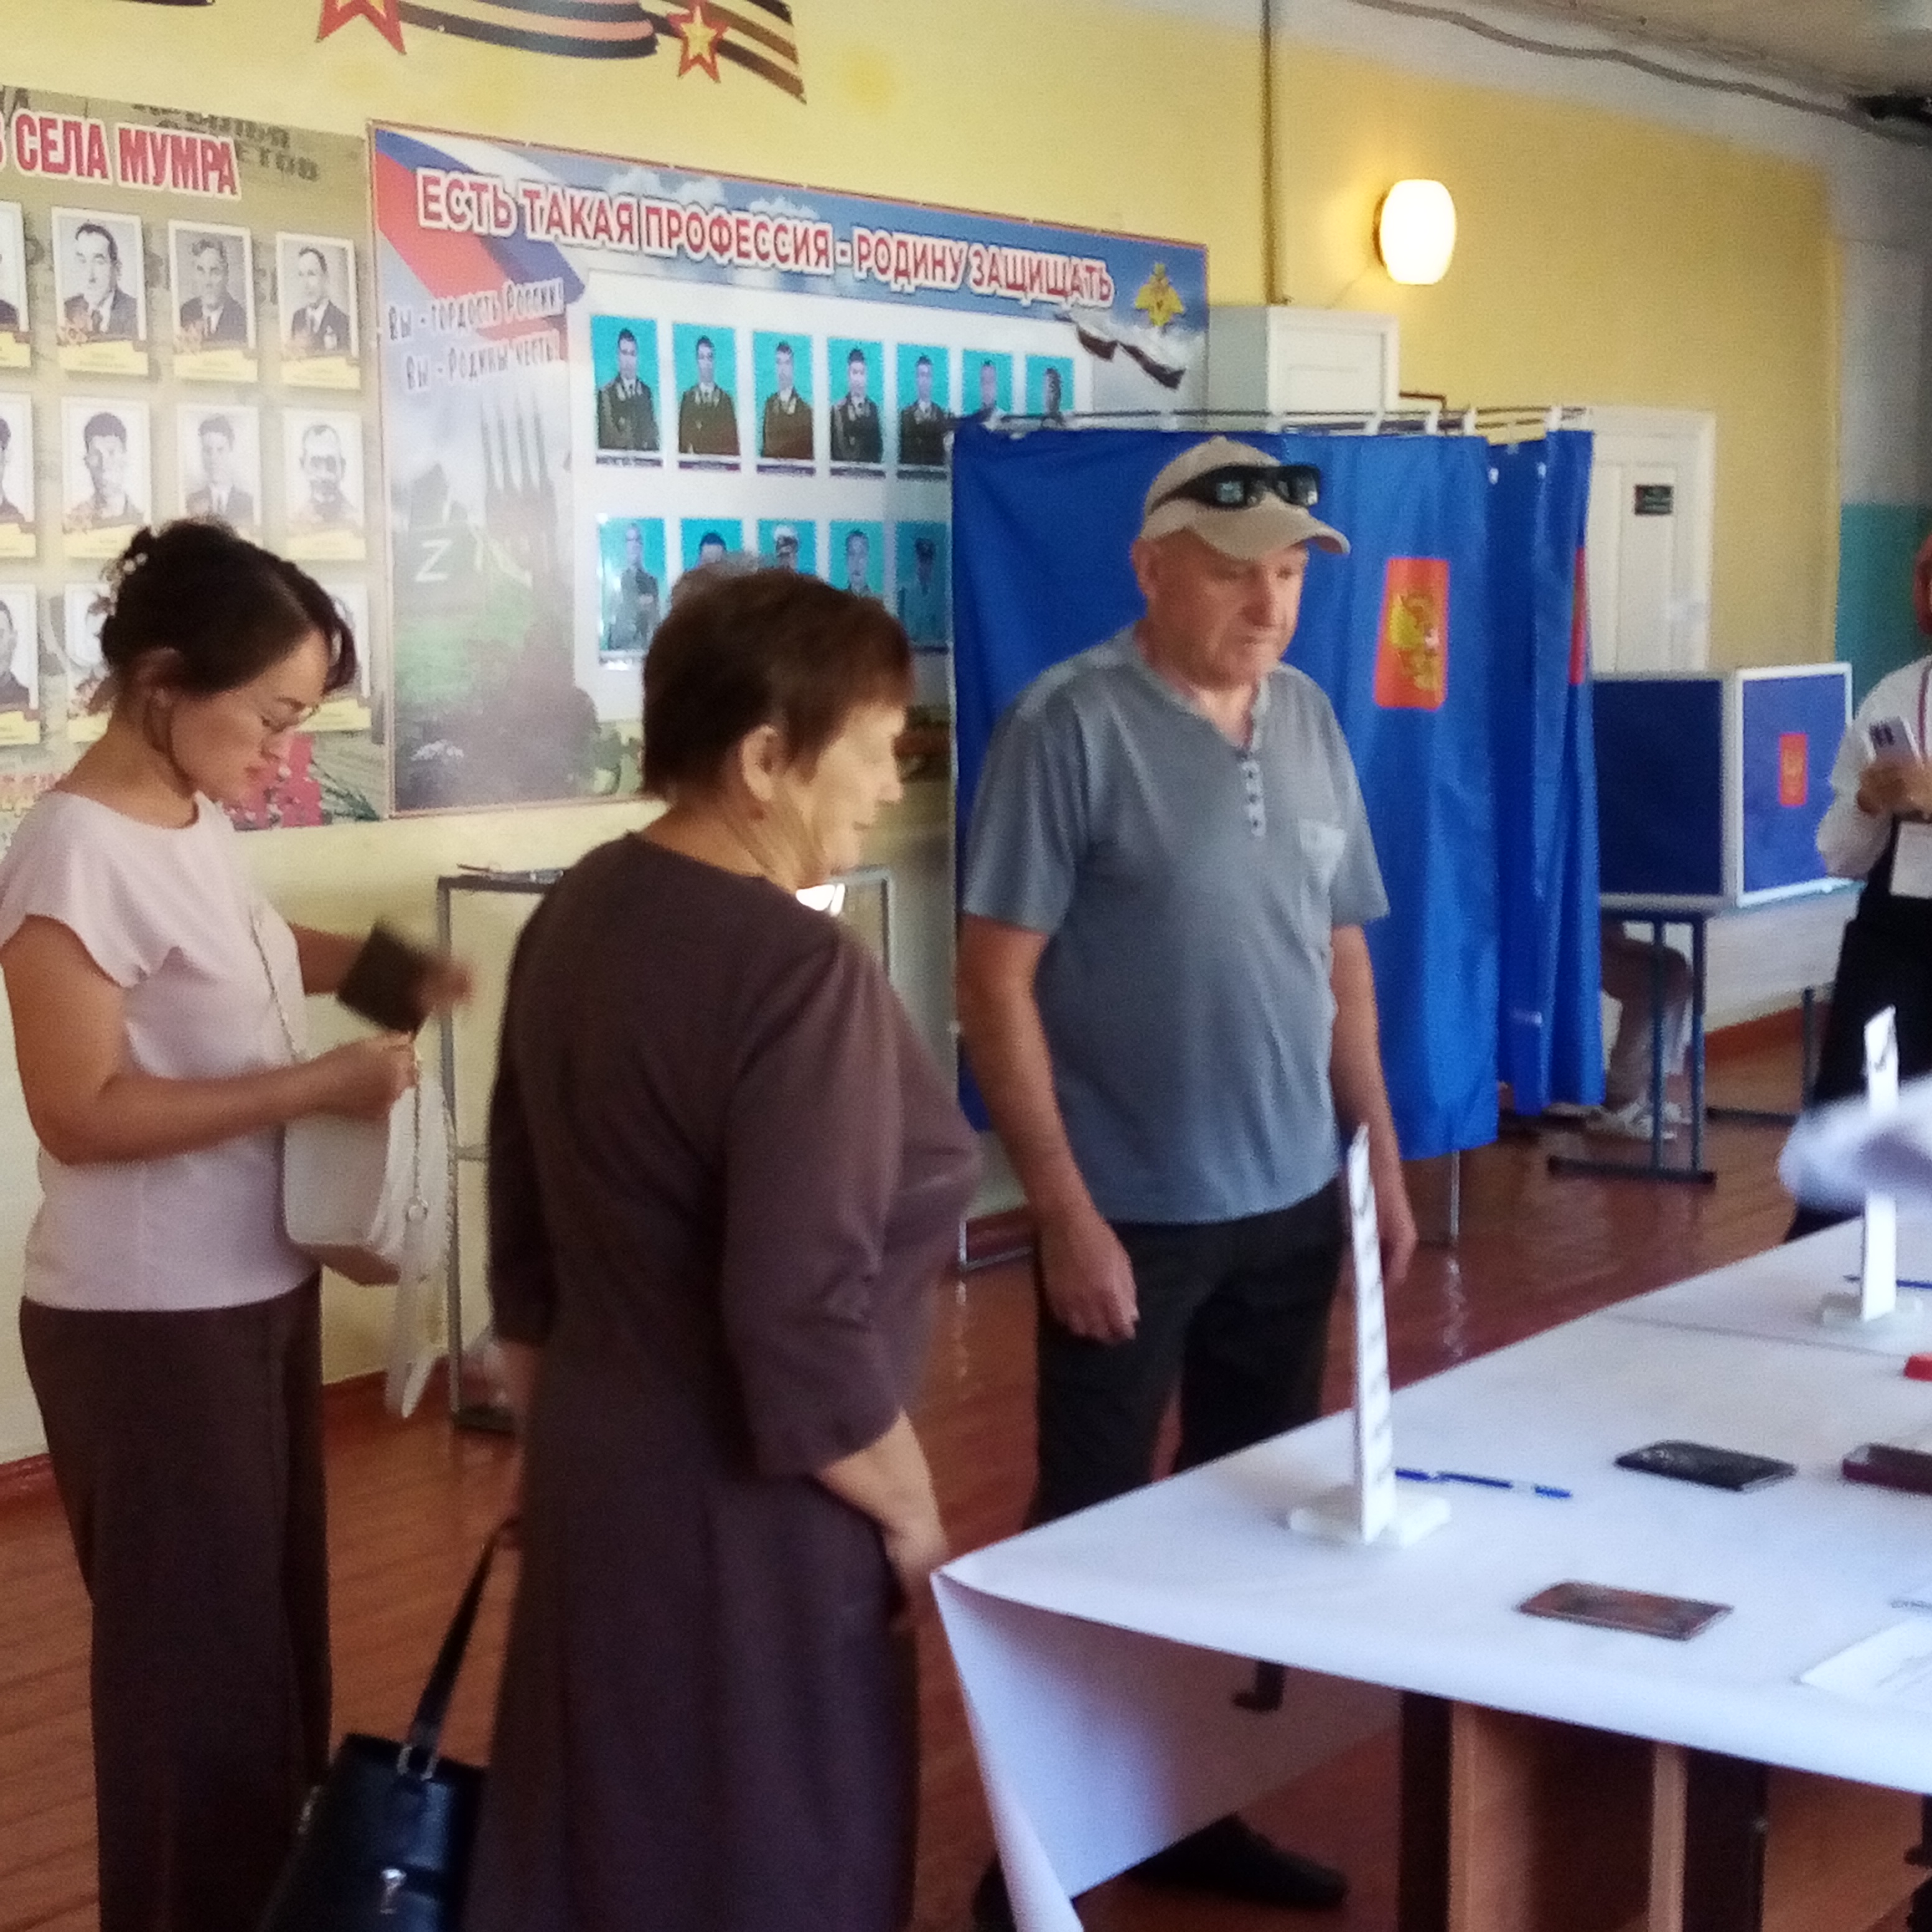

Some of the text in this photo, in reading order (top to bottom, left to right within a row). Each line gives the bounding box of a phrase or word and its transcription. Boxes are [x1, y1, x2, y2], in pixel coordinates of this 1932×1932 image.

[14, 113, 110, 180] СЕЛА
[118, 127, 238, 195] МУМРА
[421, 174, 512, 229] ЕСТЬ
[522, 188, 634, 246] ТАКАЯ
[644, 205, 832, 269] ПРОФЕССИЯ
[856, 233, 964, 283] РОДИНУ
[968, 249, 1115, 302] ЗАЩИЩАТЬ
